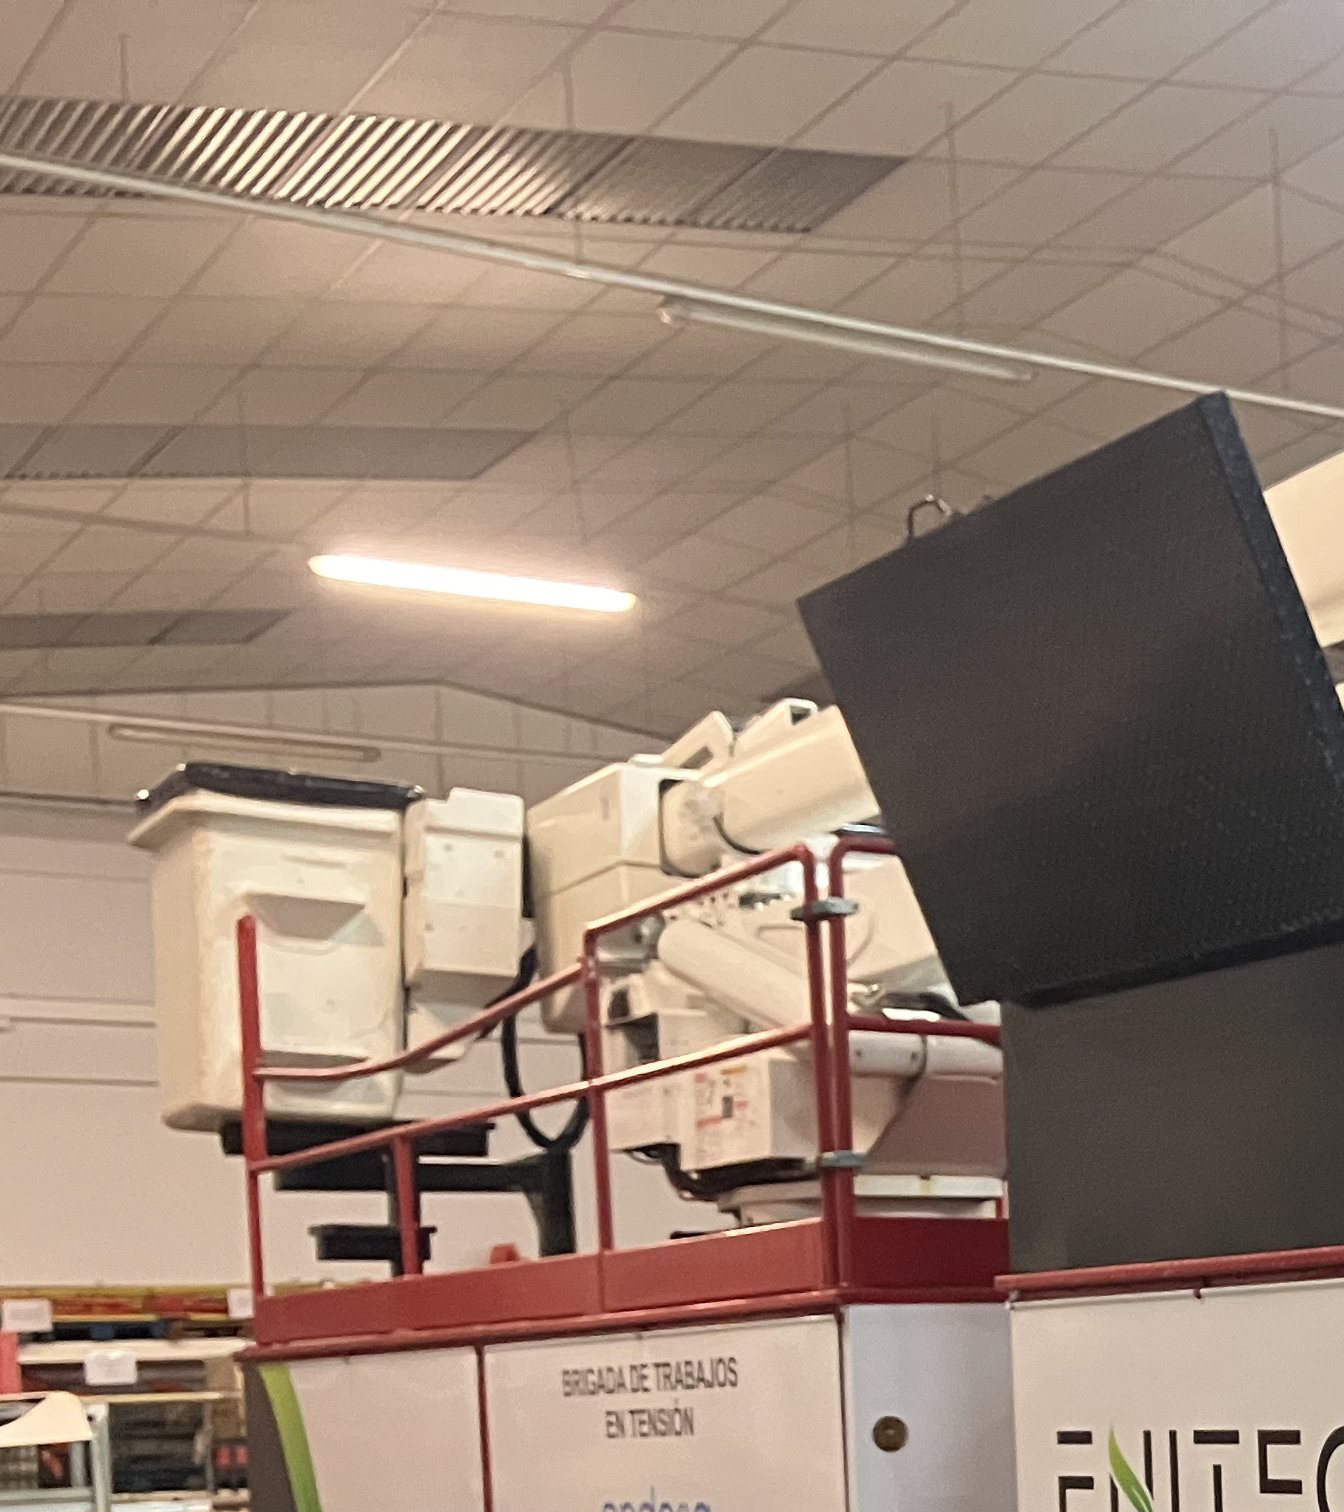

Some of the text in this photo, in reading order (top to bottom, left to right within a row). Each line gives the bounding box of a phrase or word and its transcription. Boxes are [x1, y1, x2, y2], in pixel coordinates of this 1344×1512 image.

[562, 1356, 738, 1397] BRIGADA DE TRABAJOS
[606, 1398, 694, 1438] EN TENSIÓN
